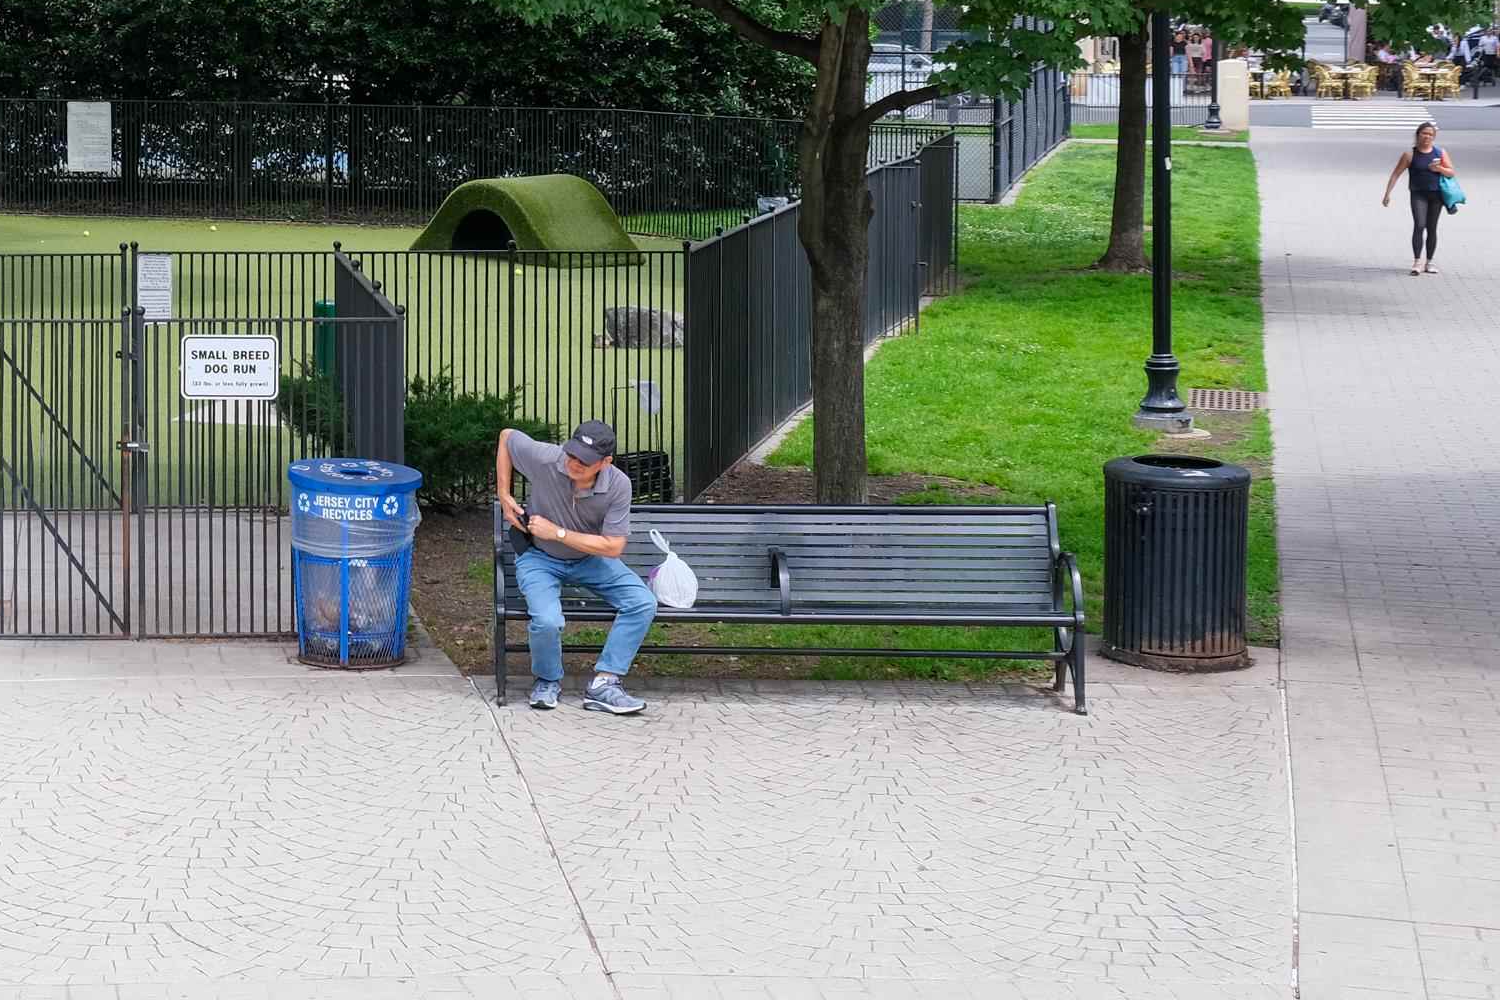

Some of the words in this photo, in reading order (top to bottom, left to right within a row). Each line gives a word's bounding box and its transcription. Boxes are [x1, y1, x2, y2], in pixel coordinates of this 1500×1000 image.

[191, 350, 228, 360] SMALL
[233, 350, 270, 360] BREED
[204, 364, 228, 374] DOG
[233, 364, 256, 374] RUN
[313, 495, 350, 508] JERSEY
[355, 496, 379, 509] CITY
[322, 508, 373, 521] RECYCLES
